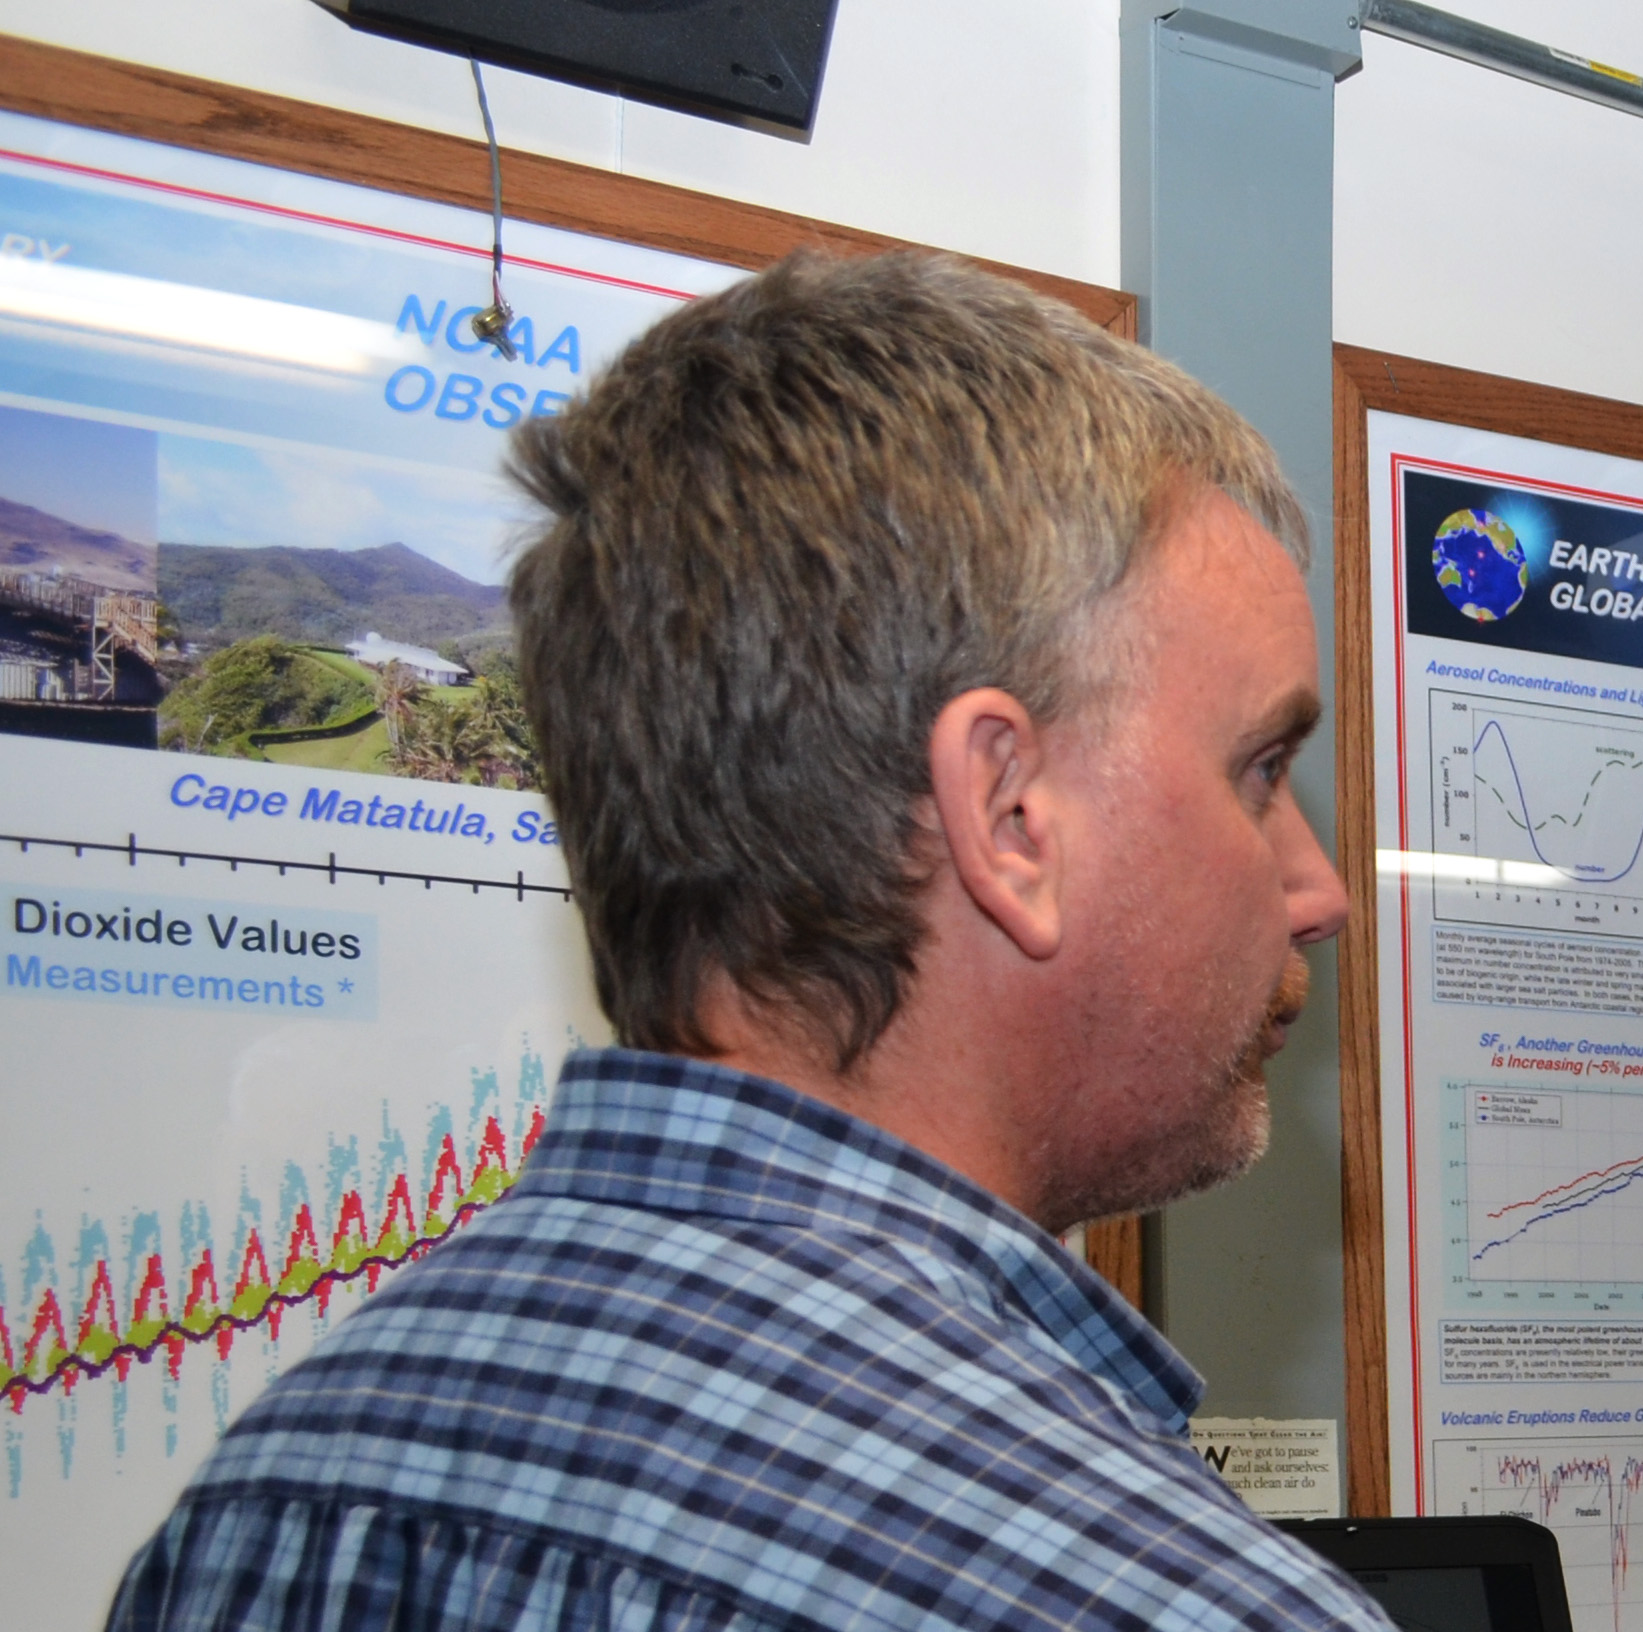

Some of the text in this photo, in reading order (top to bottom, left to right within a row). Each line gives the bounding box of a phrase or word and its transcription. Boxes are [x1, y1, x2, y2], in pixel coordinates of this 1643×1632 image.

[1426, 660, 1485, 681] Aerosol
[1487, 669, 1596, 697] Concentrations
[1600, 688, 1627, 702] and
[171, 774, 288, 820] Cape
[300, 788, 494, 843] Matatula,
[15, 898, 360, 959] Dioxide Values
[7, 955, 325, 1007] Measurements
[1516, 1036, 1574, 1053] Another
[1492, 1053, 1504, 1067] is
[1508, 1055, 1584, 1075] Increasing
[1587, 1059, 1621, 1075] (~5%
[1442, 1411, 1503, 1426] Volcanic
[1507, 1410, 1576, 1426] Eruptions
[1579, 1409, 1631, 1423] Reduce
[1255, 1448, 1272, 1461] got
[1275, 1447, 1285, 1457] to
[1288, 1449, 1319, 1460] pause
[1231, 1461, 1251, 1473] and
[1254, 1461, 1272, 1473] ask
[1254, 1477, 1281, 1489] clean
[1284, 1477, 1299, 1488] air
[1301, 1477, 1315, 1488] do
